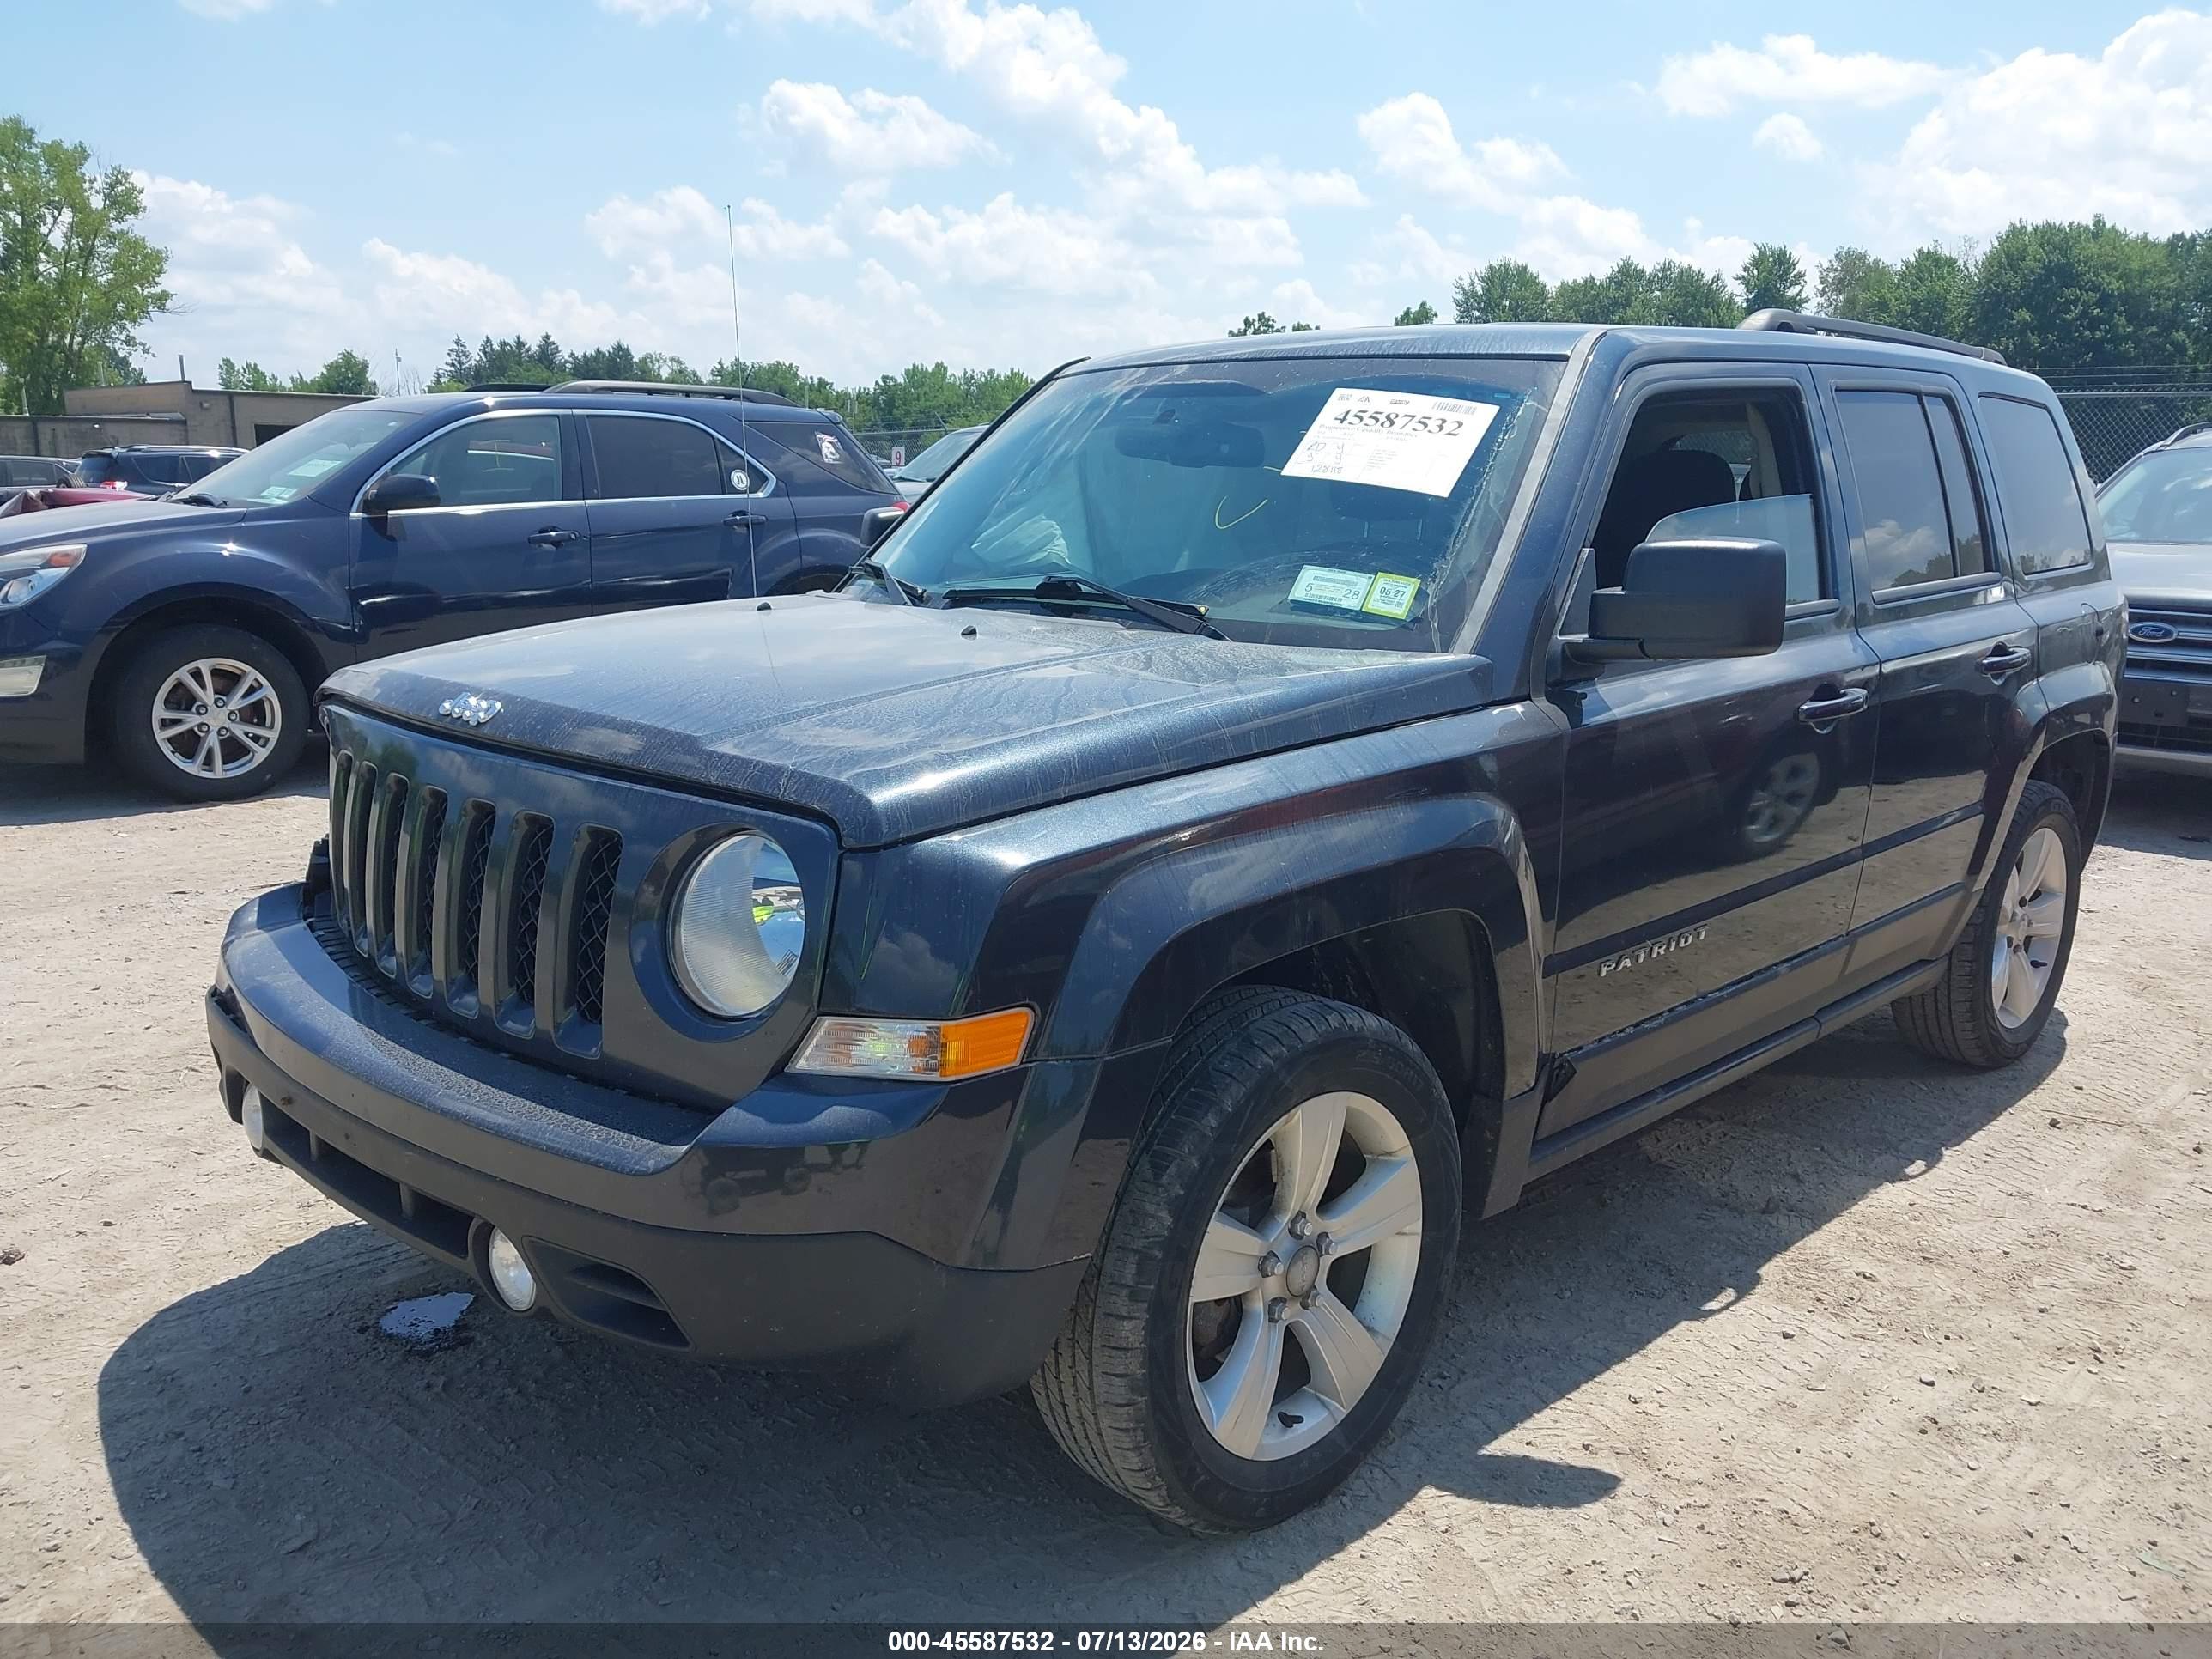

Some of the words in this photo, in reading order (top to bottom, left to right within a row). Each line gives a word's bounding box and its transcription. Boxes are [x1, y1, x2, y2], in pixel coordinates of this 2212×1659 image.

[1333, 408, 1464, 437] 45587532
[895, 451, 902, 466] 9
[1304, 582, 1315, 592] 5
[1342, 588, 1361, 600] 28
[2138, 626, 2165, 638] Ford
[1597, 923, 1711, 977] PATRIOT
